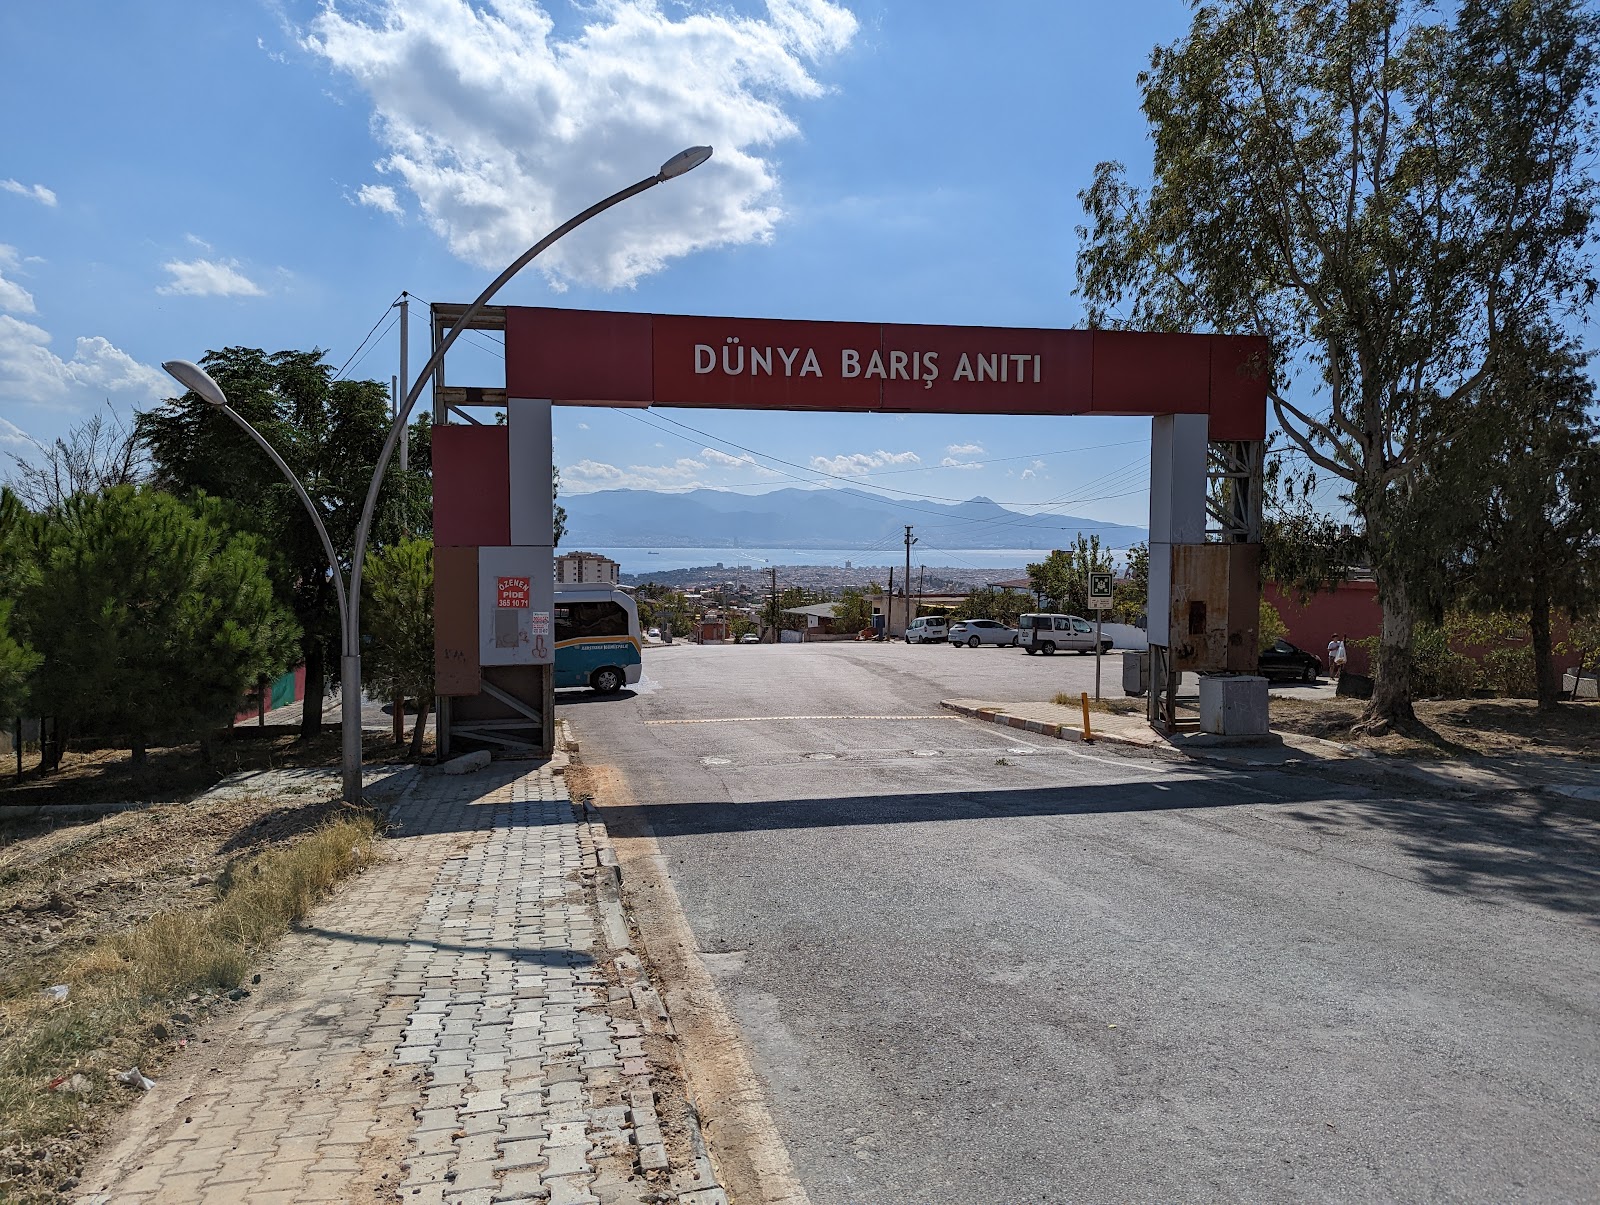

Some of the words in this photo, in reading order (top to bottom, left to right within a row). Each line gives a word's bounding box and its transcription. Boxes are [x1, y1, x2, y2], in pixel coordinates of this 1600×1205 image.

[694, 336, 823, 378] DÜNYA
[841, 349, 940, 389] BARIŞ
[953, 352, 1041, 383] ANITI
[498, 579, 530, 591] ÖZENEN
[503, 590, 524, 598] PİDE
